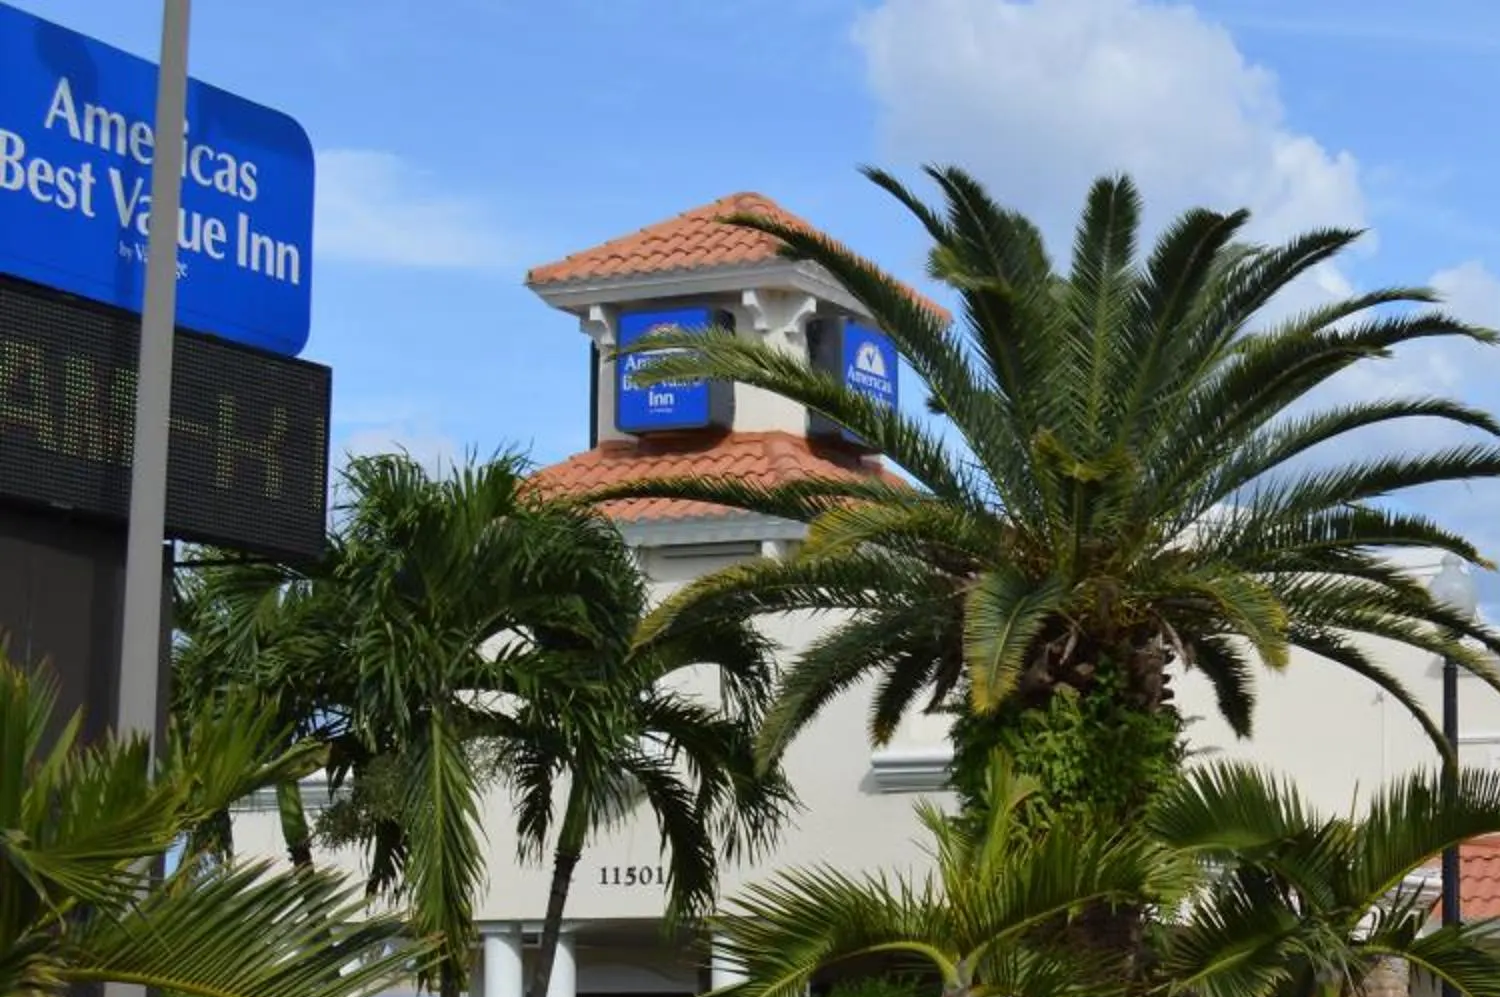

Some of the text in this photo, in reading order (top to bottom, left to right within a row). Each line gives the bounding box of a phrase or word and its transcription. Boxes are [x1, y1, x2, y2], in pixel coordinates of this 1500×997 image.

[44, 76, 258, 202] Ameicas
[0, 128, 96, 218] Best
[108, 167, 227, 260] Vaue
[237, 211, 300, 285] Inn
[648, 391, 676, 408] Inn
[599, 866, 665, 886] 11501
